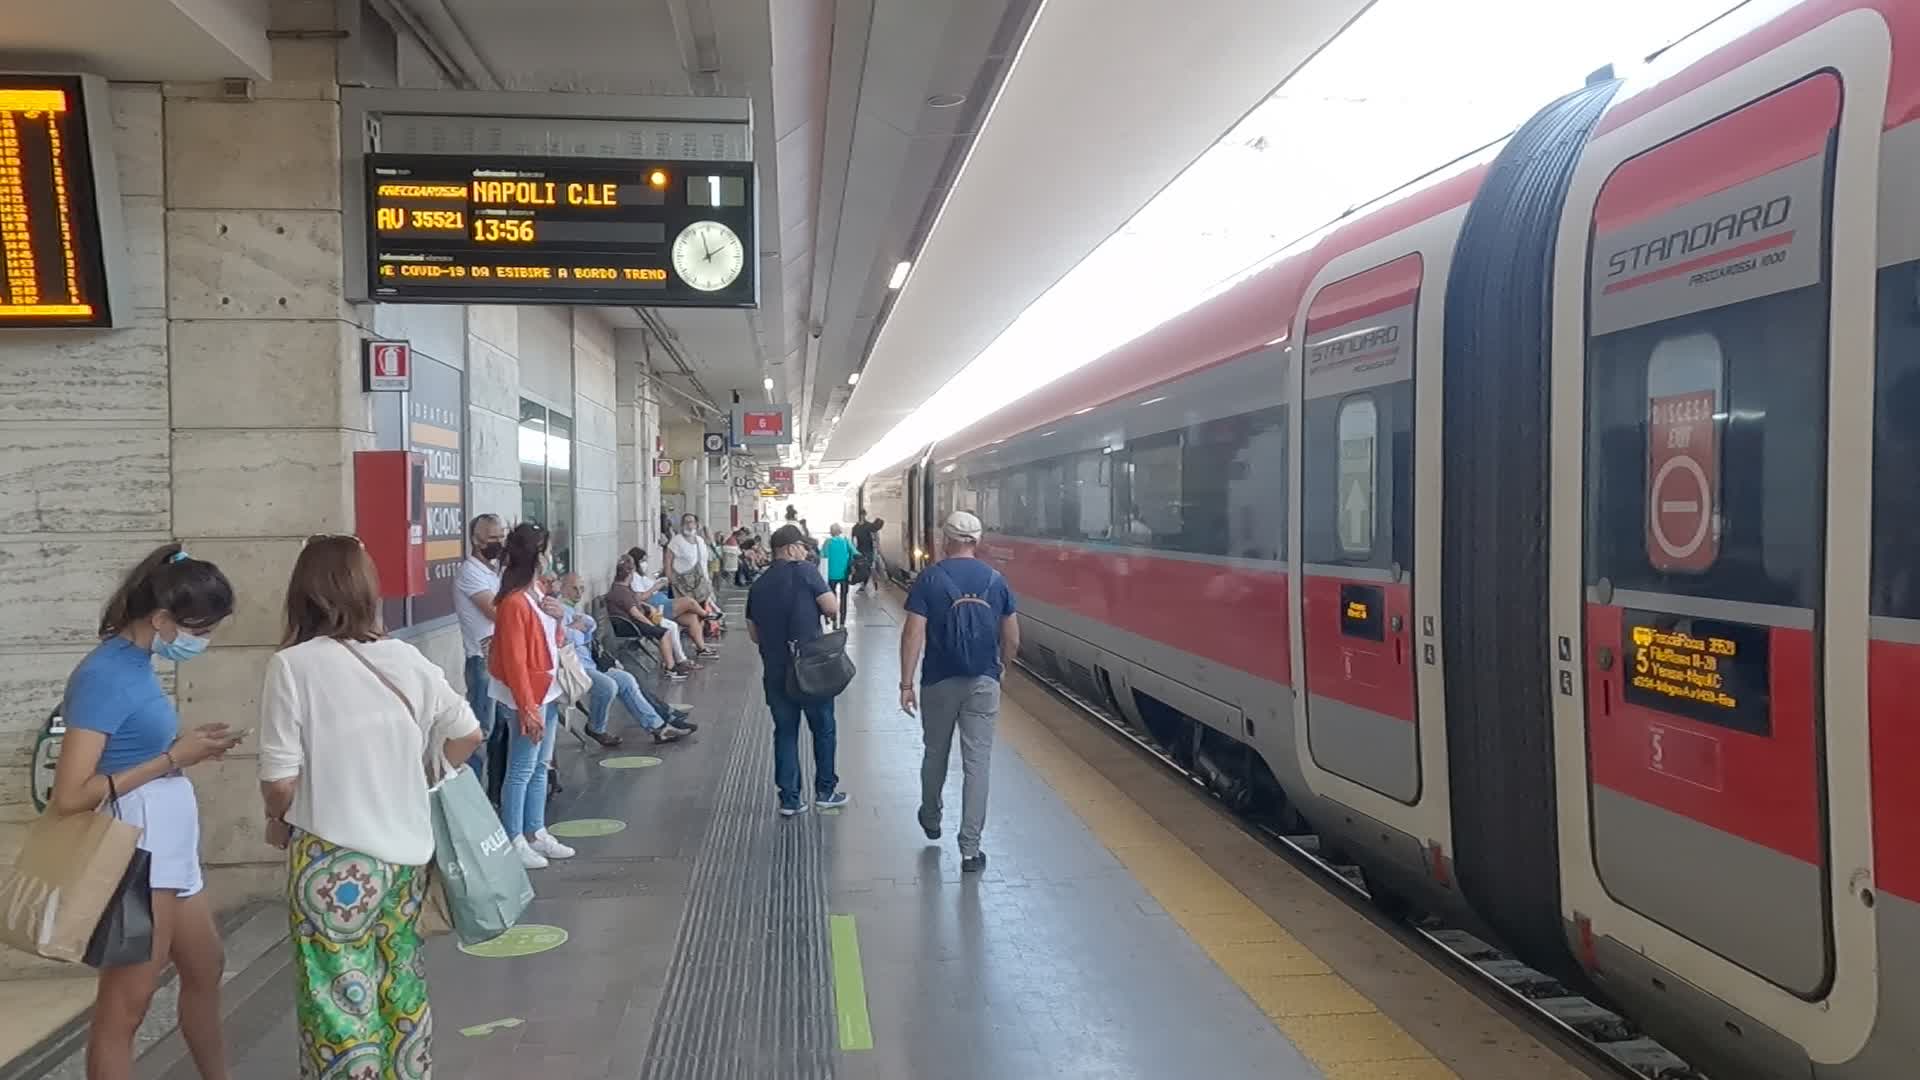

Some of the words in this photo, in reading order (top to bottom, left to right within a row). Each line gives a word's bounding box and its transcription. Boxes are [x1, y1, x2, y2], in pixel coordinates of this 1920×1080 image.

[378, 184, 468, 197] FRECCIAROSSA
[473, 181, 556, 204] NAPOLI
[567, 183, 617, 205] C.LE
[708, 175, 720, 207] 1
[377, 208, 404, 229] AV
[411, 210, 464, 228] 35521
[474, 219, 535, 241] 13:56
[1608, 195, 1792, 277] STANDARD
[400, 265, 466, 277] COVID-19
[471, 266, 490, 277] DA
[496, 266, 552, 278] ESIBIRE
[558, 267, 568, 278] A
[573, 268, 618, 279] BORDO
[1636, 647, 1649, 673] 5
